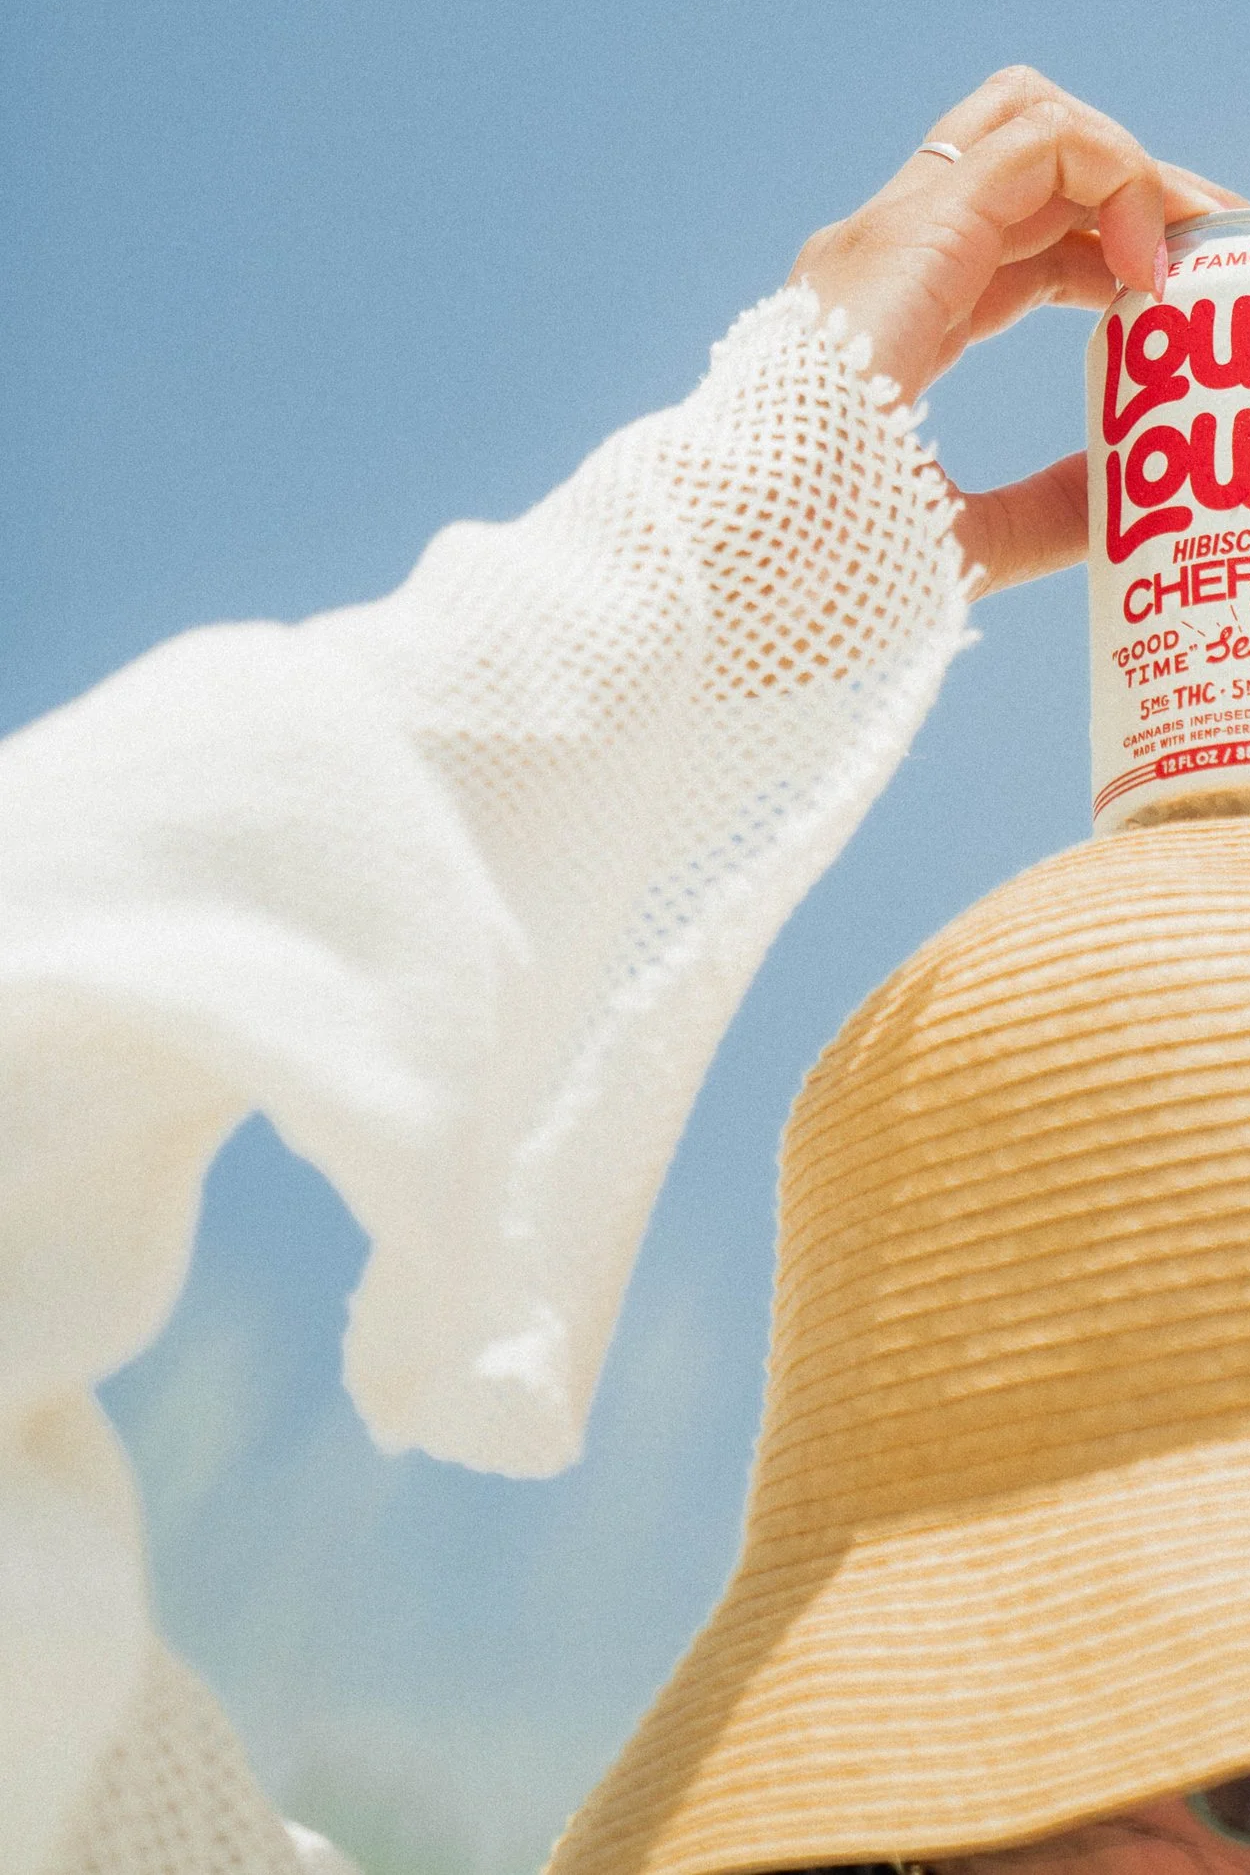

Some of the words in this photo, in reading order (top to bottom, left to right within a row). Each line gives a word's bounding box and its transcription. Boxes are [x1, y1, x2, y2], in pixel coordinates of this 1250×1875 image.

[1172, 681, 1217, 710] THC
[1122, 719, 1184, 749] CANNABIS
[1133, 744, 1156, 759] MADE
[1160, 733, 1185, 748] WITH
[1161, 758, 1177, 775] 12
[1178, 755, 1194, 770] FL
[1196, 749, 1219, 765] OZ
